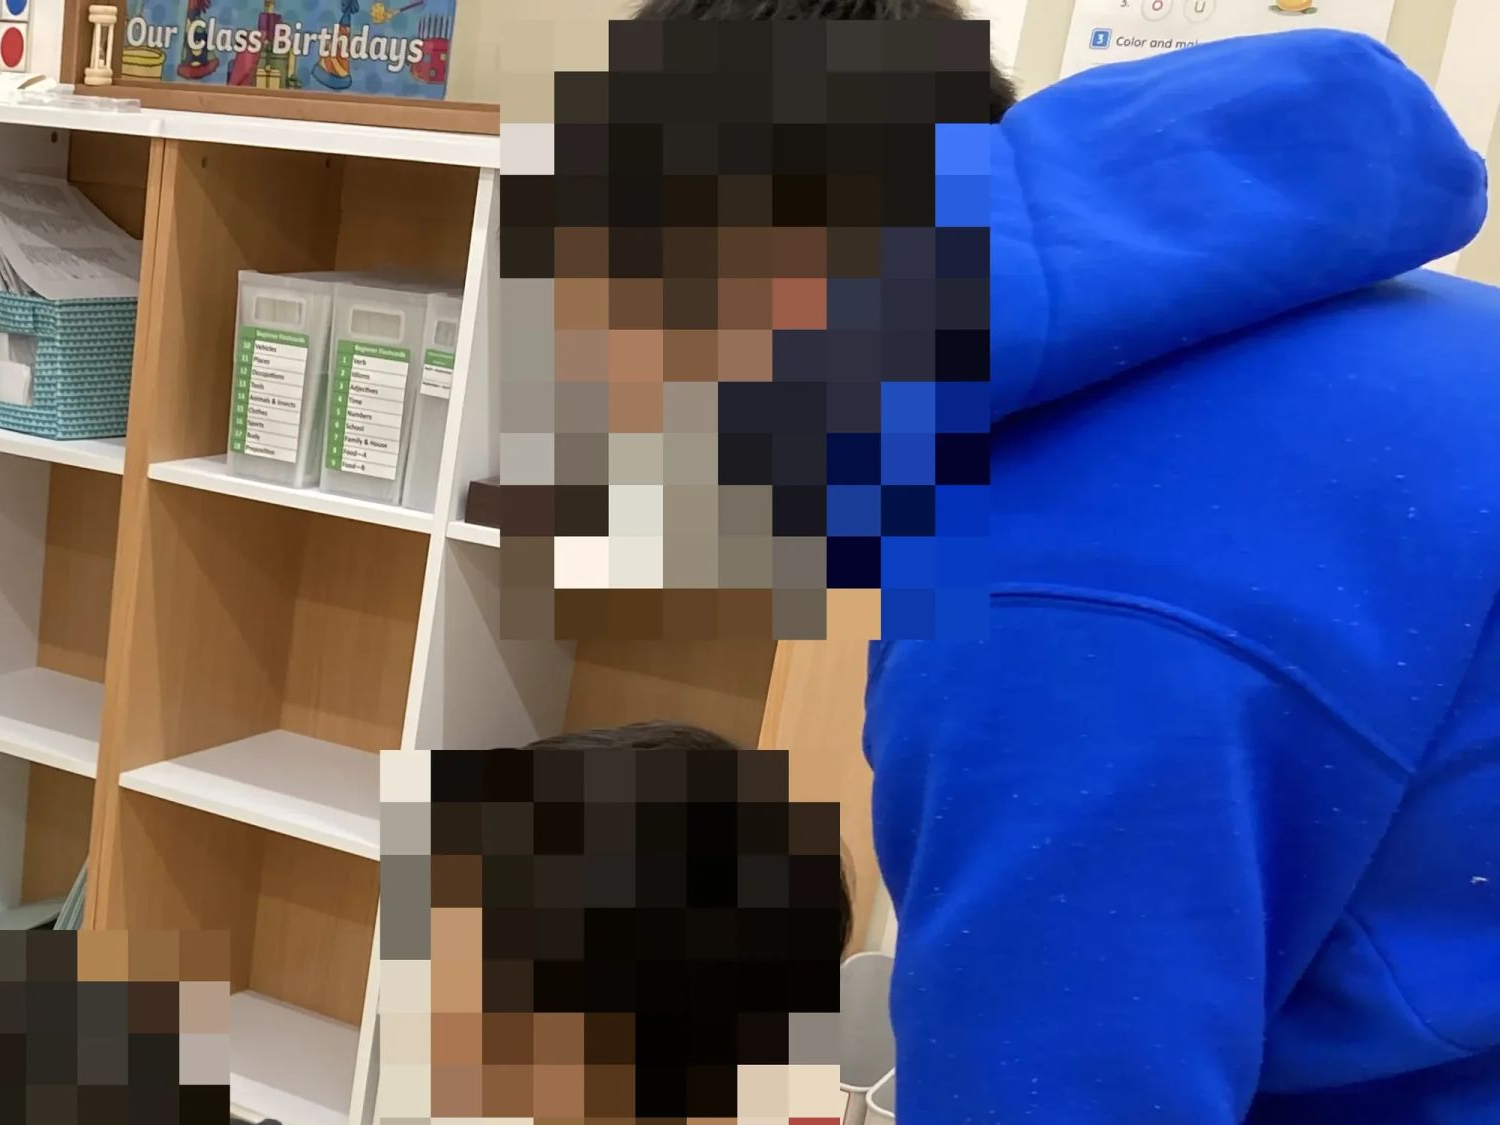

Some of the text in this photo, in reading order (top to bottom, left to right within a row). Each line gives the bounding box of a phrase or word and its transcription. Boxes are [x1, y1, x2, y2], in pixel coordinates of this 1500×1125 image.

[126, 16, 424, 72] Our Class Birthdays
[1116, 36, 1147, 47] Color
[1150, 39, 1173, 49] and
[350, 384, 379, 395] Adjectives
[349, 397, 362, 405] Time
[348, 411, 372, 420] Numbers
[346, 423, 365, 432] School
[345, 436, 362, 446] Family
[370, 440, 388, 449] House
